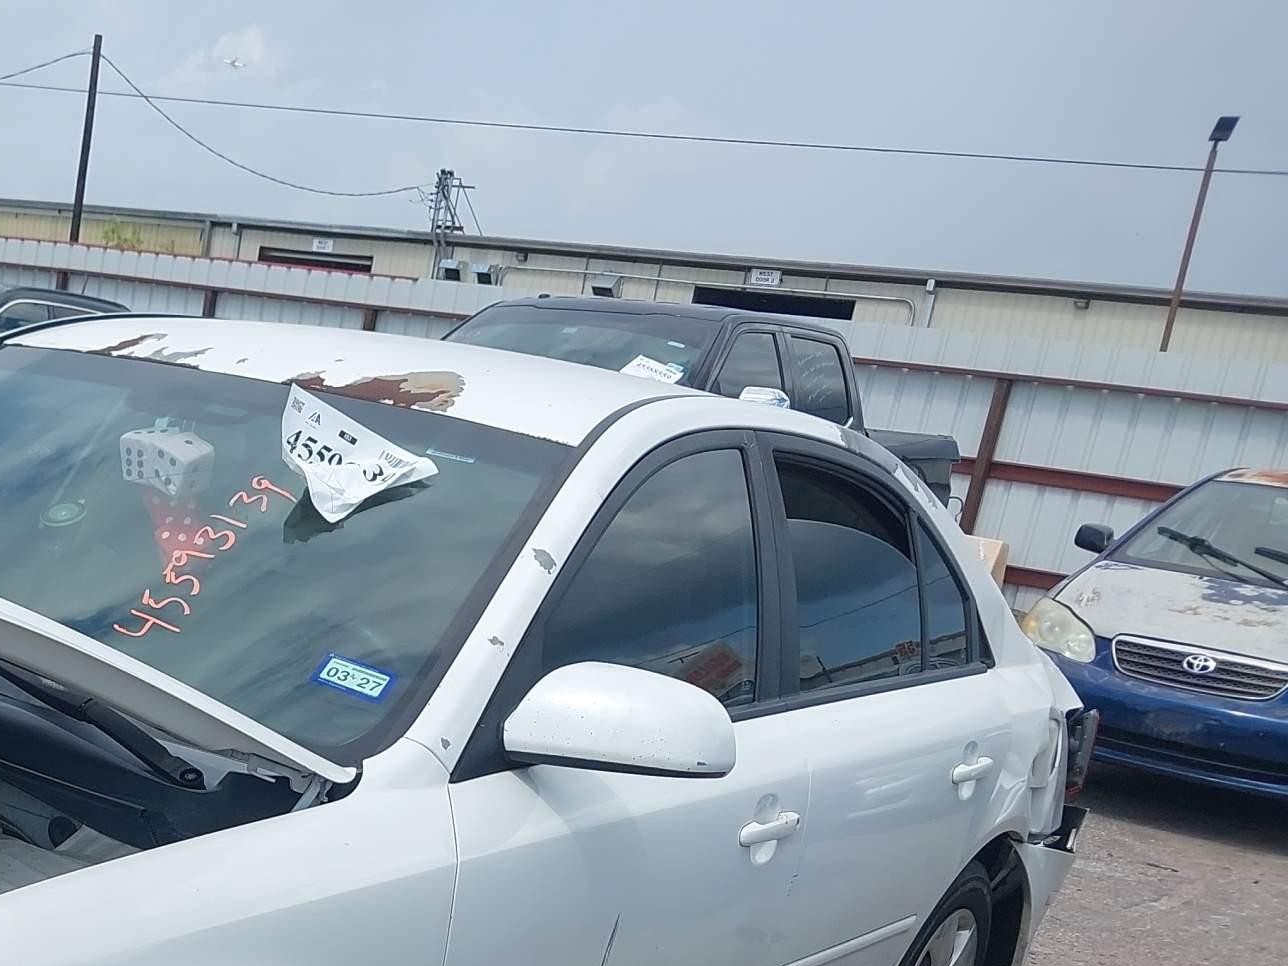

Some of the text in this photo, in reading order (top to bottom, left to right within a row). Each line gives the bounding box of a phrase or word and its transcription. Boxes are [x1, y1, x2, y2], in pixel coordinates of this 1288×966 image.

[112, 475, 298, 637] 45593139
[326, 666, 351, 683] 03
[356, 677, 384, 692] 27
